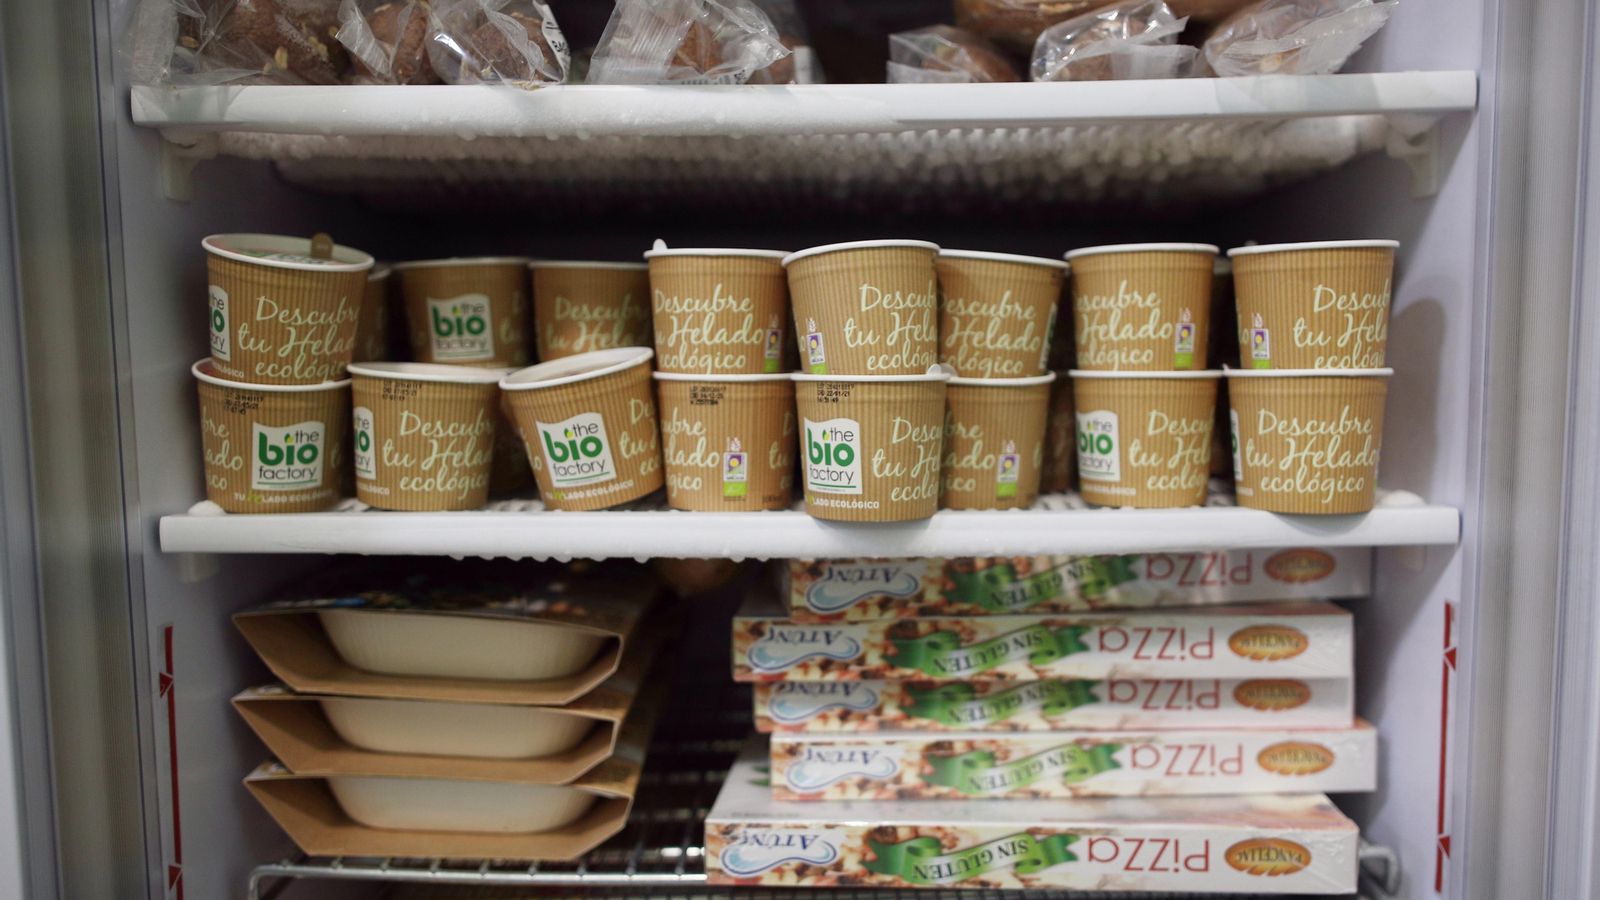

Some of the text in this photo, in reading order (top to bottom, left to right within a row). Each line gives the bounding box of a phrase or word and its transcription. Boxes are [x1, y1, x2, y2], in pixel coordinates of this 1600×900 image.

[256, 295, 361, 325] Descubr
[945, 289, 1036, 320] escubre
[1313, 279, 1391, 313] Descub
[238, 322, 272, 353] tu
[433, 306, 487, 338] bio
[668, 313, 764, 347] Helado
[844, 318, 880, 348] tu
[1080, 307, 1173, 345] Helado
[1293, 316, 1331, 347] tu
[659, 344, 747, 374] cológico
[295, 427, 319, 443] the
[573, 421, 599, 439] the
[830, 427, 854, 441] the
[1258, 405, 1373, 437] Descubre
[258, 431, 319, 466] bio
[383, 438, 417, 468] tu
[543, 429, 604, 463] bio
[619, 431, 647, 460] tu
[668, 433, 721, 468] lado
[807, 427, 855, 467] bio
[1129, 438, 1163, 468] tu
[1246, 438, 1274, 467] tu
[257, 464, 318, 482] factory
[553, 458, 607, 477] factory
[809, 466, 855, 485] factory
[872, 448, 906, 478] tu
[1260, 464, 1365, 504] ecológico
[830, 498, 880, 509] ECOLÓGICO
[933, 632, 1044, 675] SIN GLUTEN
[948, 689, 1022, 724] GLUTEN
[967, 749, 1079, 793] SIN GLUTEN
[912, 838, 1031, 881] SIN GLUTEN
